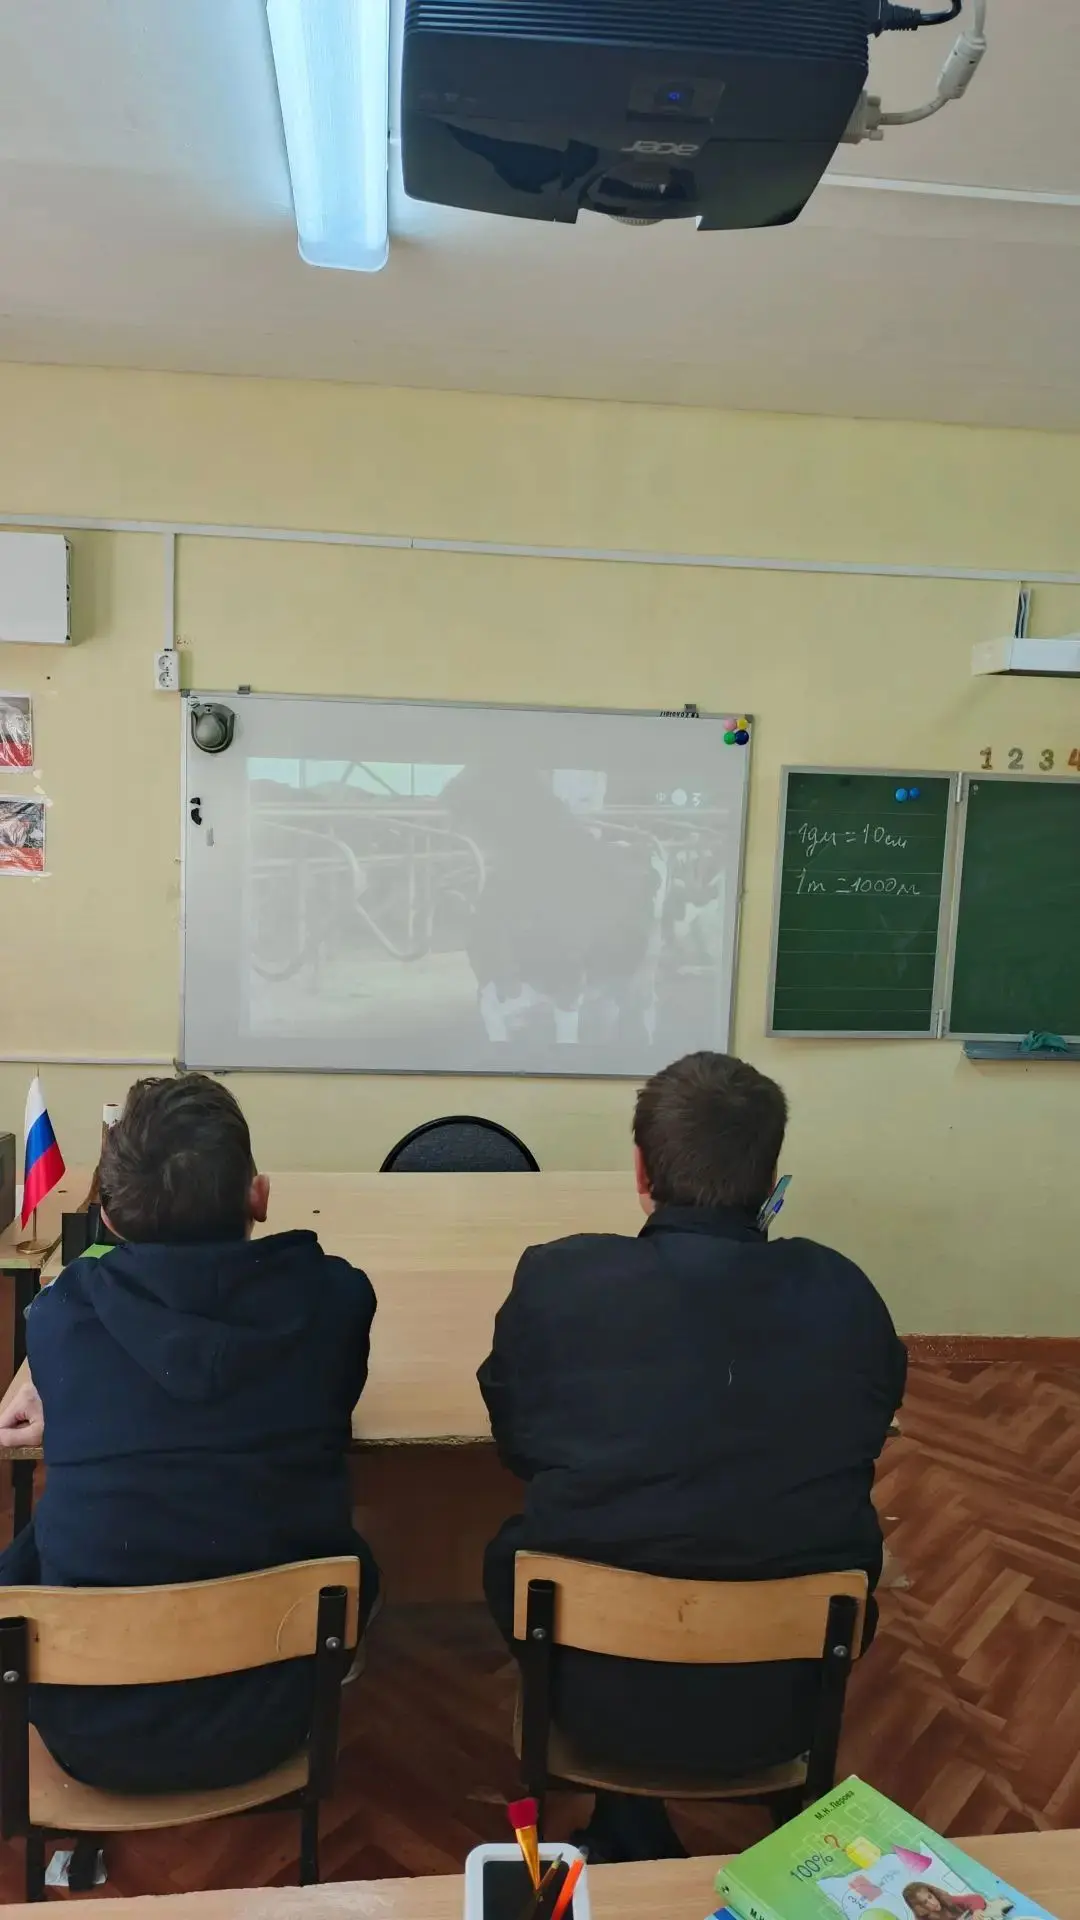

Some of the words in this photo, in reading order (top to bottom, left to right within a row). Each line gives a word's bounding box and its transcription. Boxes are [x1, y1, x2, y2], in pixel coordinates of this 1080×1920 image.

[621, 141, 699, 155] acer
[980, 747, 993, 770] 1
[1008, 747, 1024, 770] 2
[1039, 748, 1054, 771] 3
[790, 1852, 834, 1882] 100%
